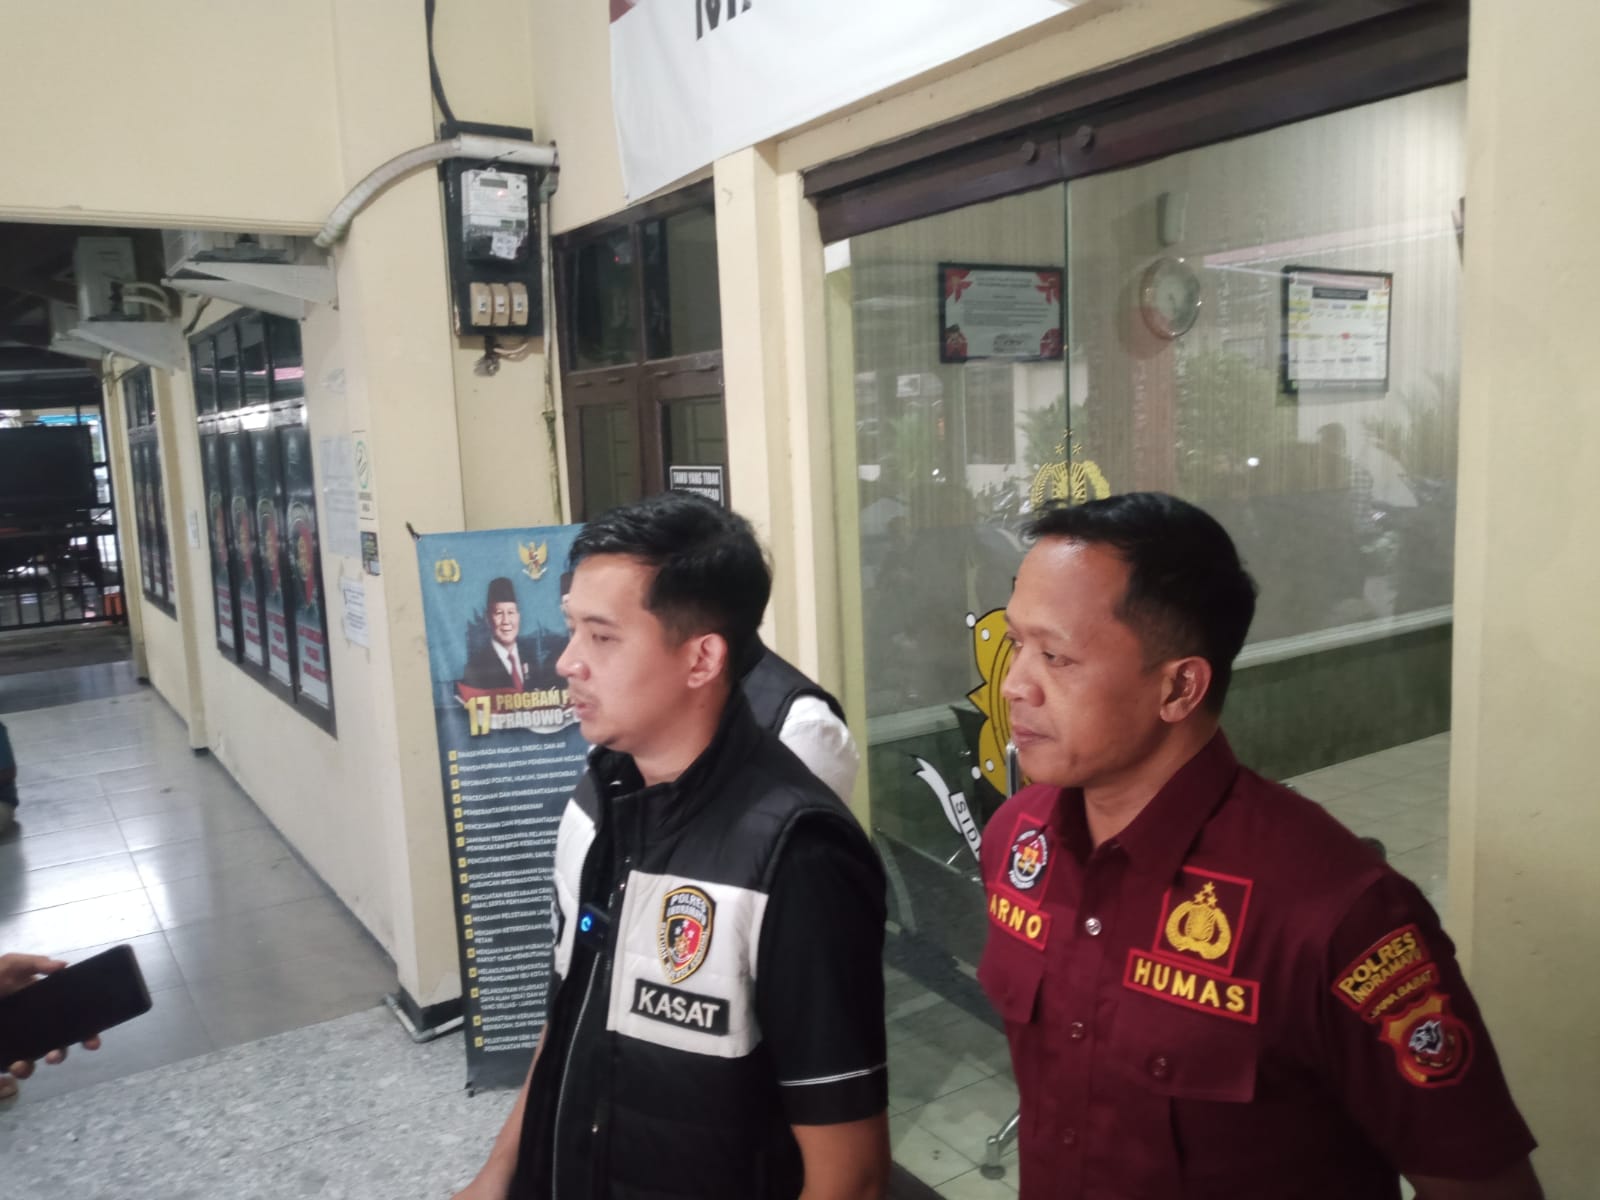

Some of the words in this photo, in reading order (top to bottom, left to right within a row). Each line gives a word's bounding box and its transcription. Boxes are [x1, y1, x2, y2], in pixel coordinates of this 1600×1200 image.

[464, 695, 491, 736] 17
[496, 689, 560, 710] PROGRAM
[499, 708, 563, 729] PRABOWO
[669, 893, 708, 914] POLRES
[990, 894, 1042, 939] ARNO
[1338, 931, 1417, 996] POLRES
[1134, 958, 1245, 1012] HUMAS
[638, 987, 720, 1028] KASAT
